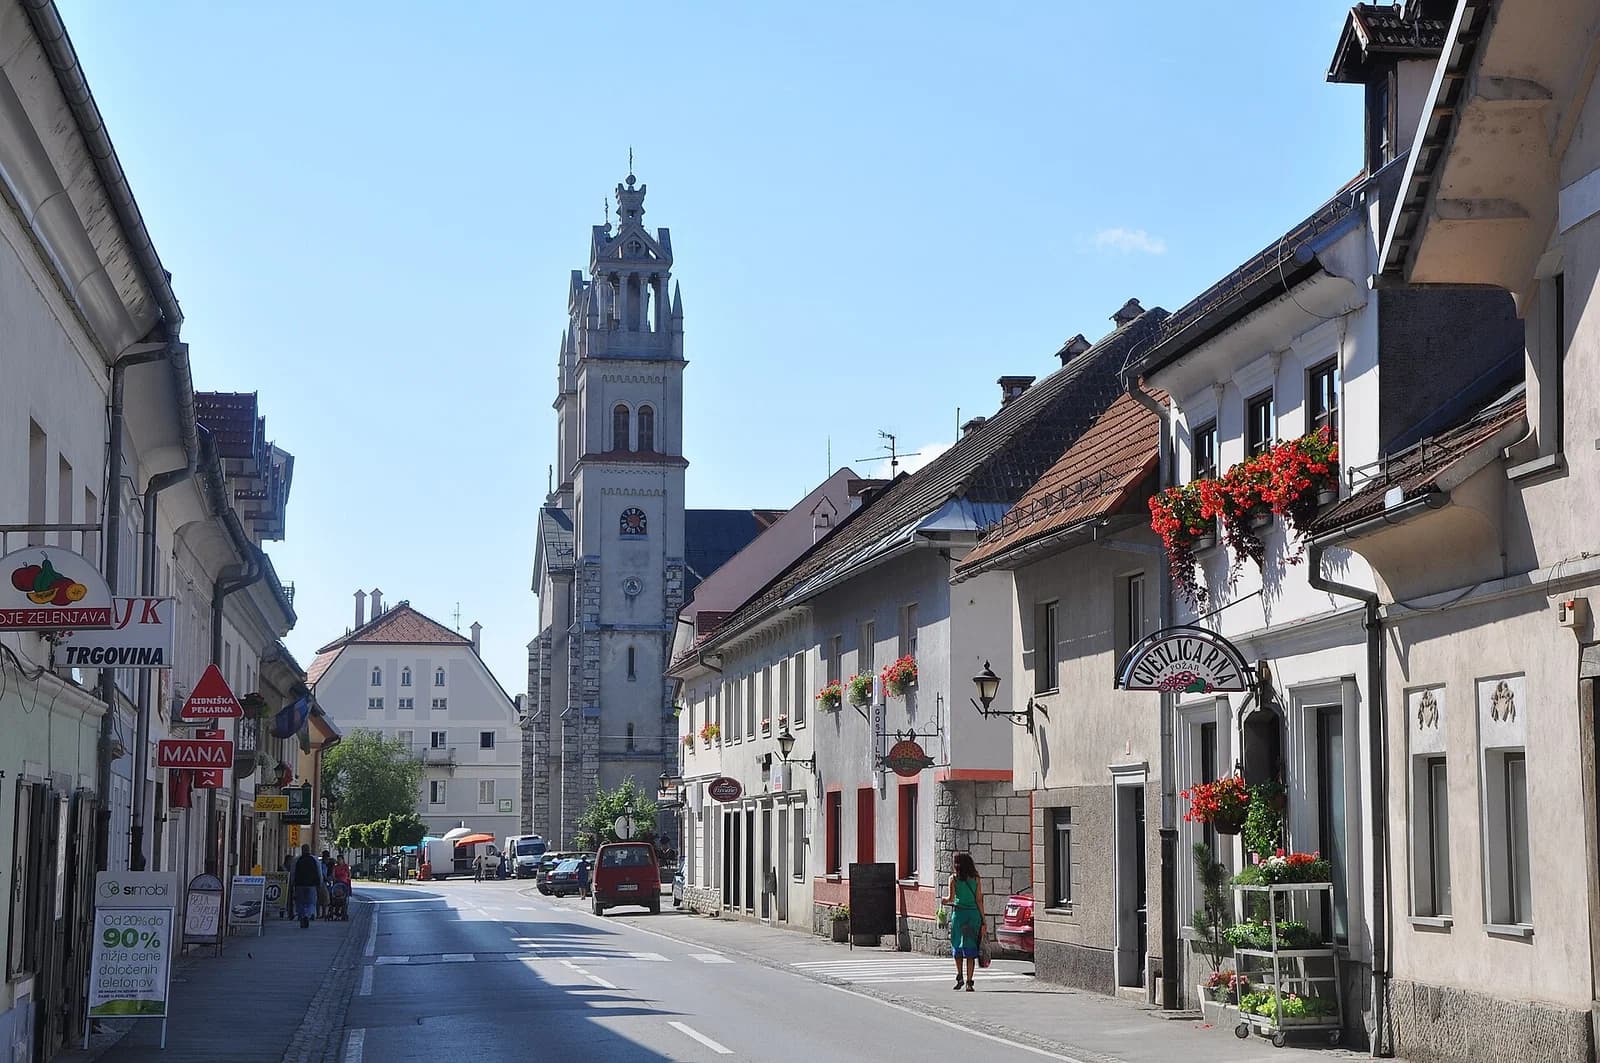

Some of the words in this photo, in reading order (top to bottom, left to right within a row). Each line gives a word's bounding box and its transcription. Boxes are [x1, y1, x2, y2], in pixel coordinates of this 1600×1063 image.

[27, 611, 106, 624] ZELENJAVA
[66, 646, 164, 665] TRGOVINA
[1170, 661, 1200, 672] POŽAR
[191, 695, 234, 705] RIBNIŠKA
[191, 706, 233, 714] PEKARNA
[163, 745, 227, 763] MANA
[103, 915, 121, 926] Od
[123, 915, 147, 926] 20%
[148, 915, 163, 926] do
[103, 928, 160, 949] 90%
[131, 952, 161, 962] cene
